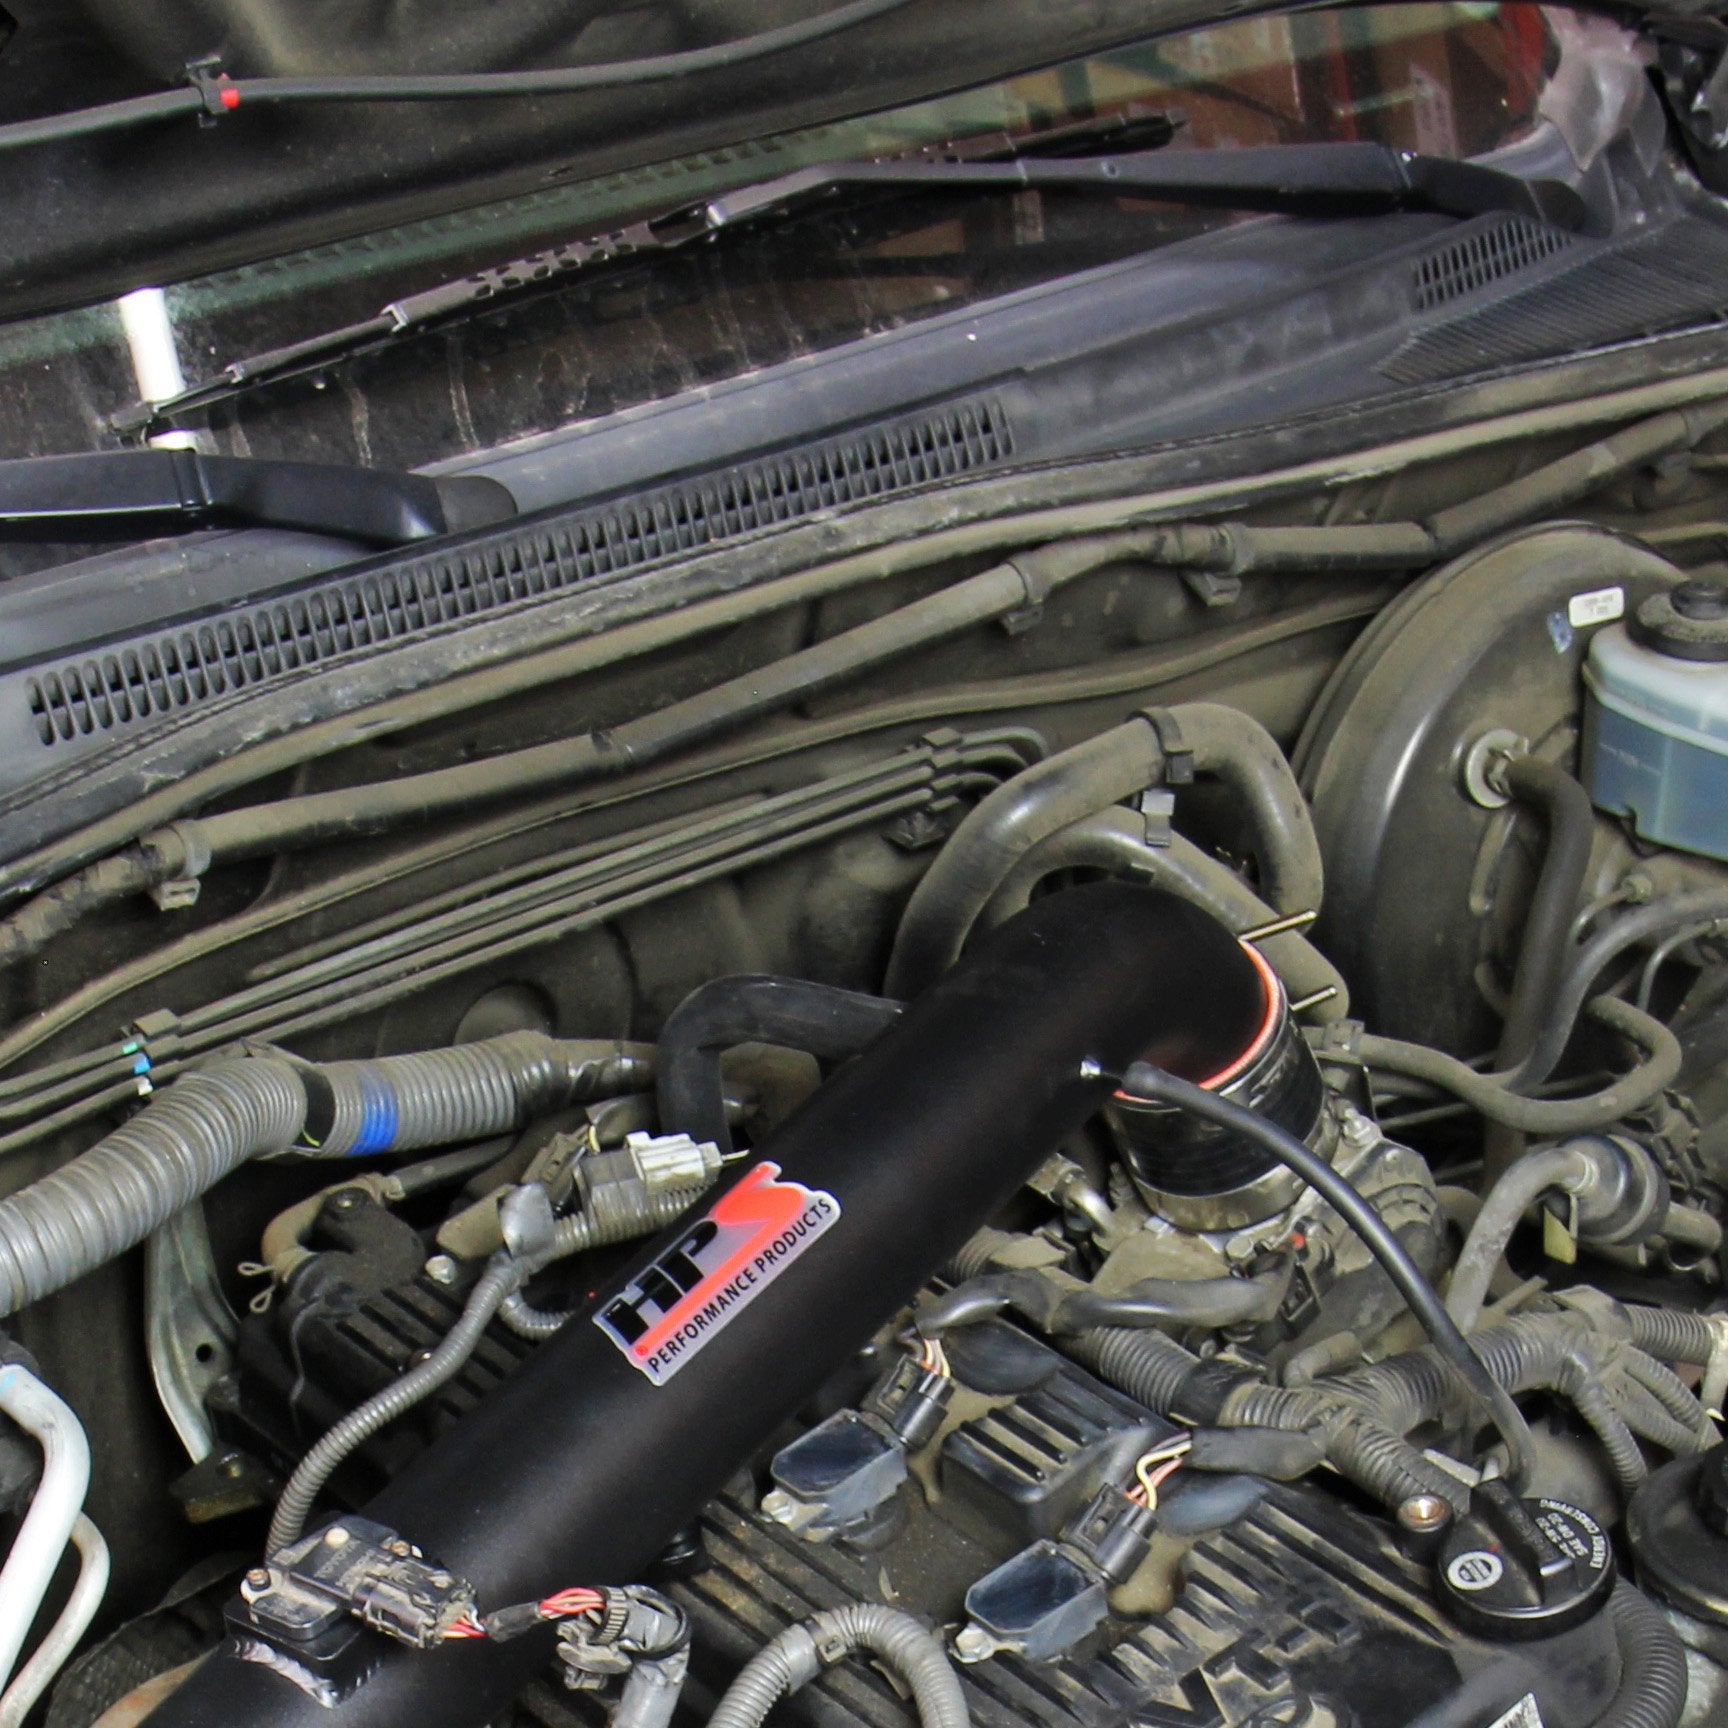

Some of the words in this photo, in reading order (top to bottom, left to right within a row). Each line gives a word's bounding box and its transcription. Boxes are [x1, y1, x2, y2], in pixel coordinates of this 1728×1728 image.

[601, 1163, 806, 1358] HPS
[648, 1267, 757, 1373] PERFORMANCE
[755, 1198, 833, 1274] PRODUCTS
